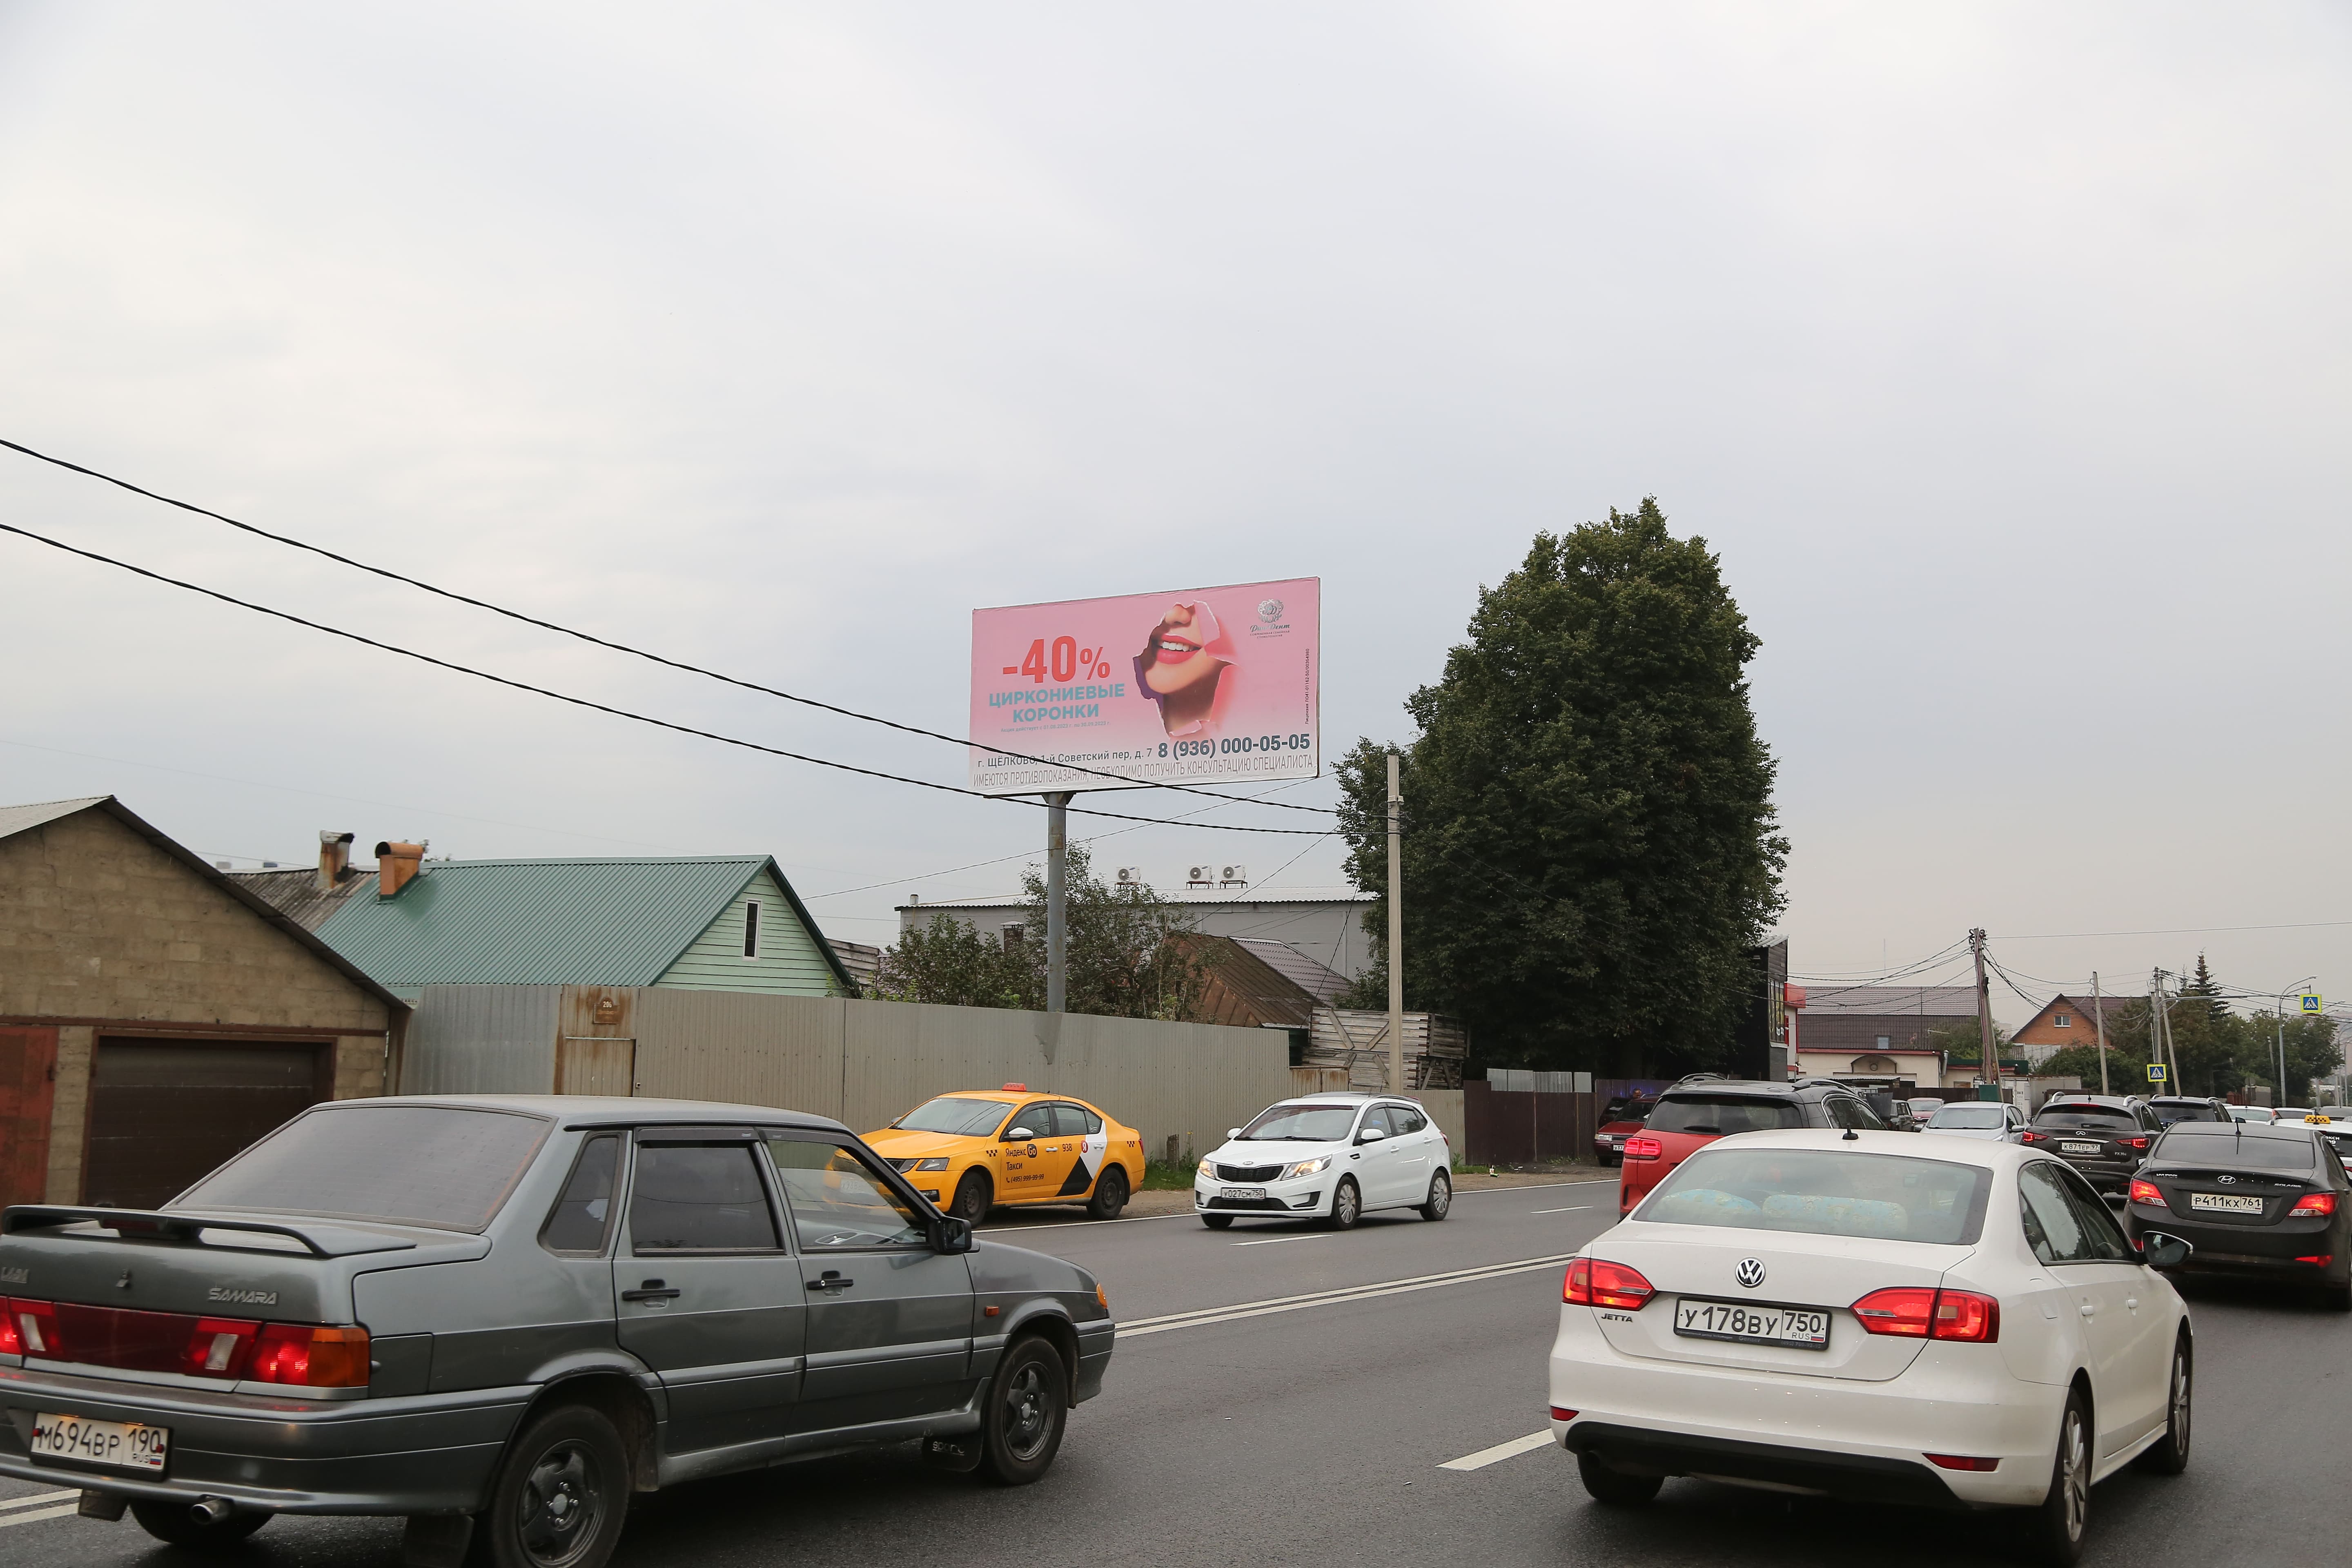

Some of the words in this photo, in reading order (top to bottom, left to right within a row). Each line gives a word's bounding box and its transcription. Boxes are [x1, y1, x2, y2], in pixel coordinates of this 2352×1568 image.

[1003, 636, 1110, 684] -40%
[989, 683, 1125, 708] ЦИРКОНИЕВЫЕ
[1013, 703, 1099, 723] КОРОНКИ
[988, 755, 1038, 768] ЩЁЛКОВО,
[1041, 754, 1055, 764] 1-й
[1058, 751, 1109, 762] Советский
[1112, 751, 1132, 761] пер,
[1135, 751, 1144, 760] д.
[1146, 748, 1152, 757] 7
[1158, 742, 1168, 757] 8
[1173, 738, 1216, 761] (936)
[1221, 733, 1310, 754] 000-05-05
[973, 772, 1008, 787] ИМЕЮТСЯ
[1010, 768, 1089, 785] ПРОТИВОПОКАЗАНИЯ,
[1091, 764, 1142, 781] НЕОБХОДИМО
[1144, 761, 1185, 777] ПОЛУЧИТЬ
[1187, 757, 1251, 775] КОНСУЛЬТАЦИЮ
[1254, 754, 1313, 772] СПЕЦИАЛИСТА
[1006, 1148, 1027, 1158] Яндекс
[1028, 1146, 1036, 1156] Go
[1062, 1143, 1072, 1152] 938
[1082, 1142, 1087, 1151] Я
[1006, 1162, 1022, 1171] Такси
[1023, 1174, 1044, 1182] 999-99-99
[2195, 1196, 2240, 1208] Р411КХ
[2242, 1198, 2260, 1207] 761
[208, 1287, 278, 1305] SAMARA
[1601, 1313, 1633, 1322] JETTA
[1685, 1306, 1778, 1335] У178ВУ
[1784, 1312, 1821, 1333] 750
[39, 1421, 120, 1458] М694ВР
[128, 1428, 160, 1453] 190
[132, 1452, 150, 1463] RUS
